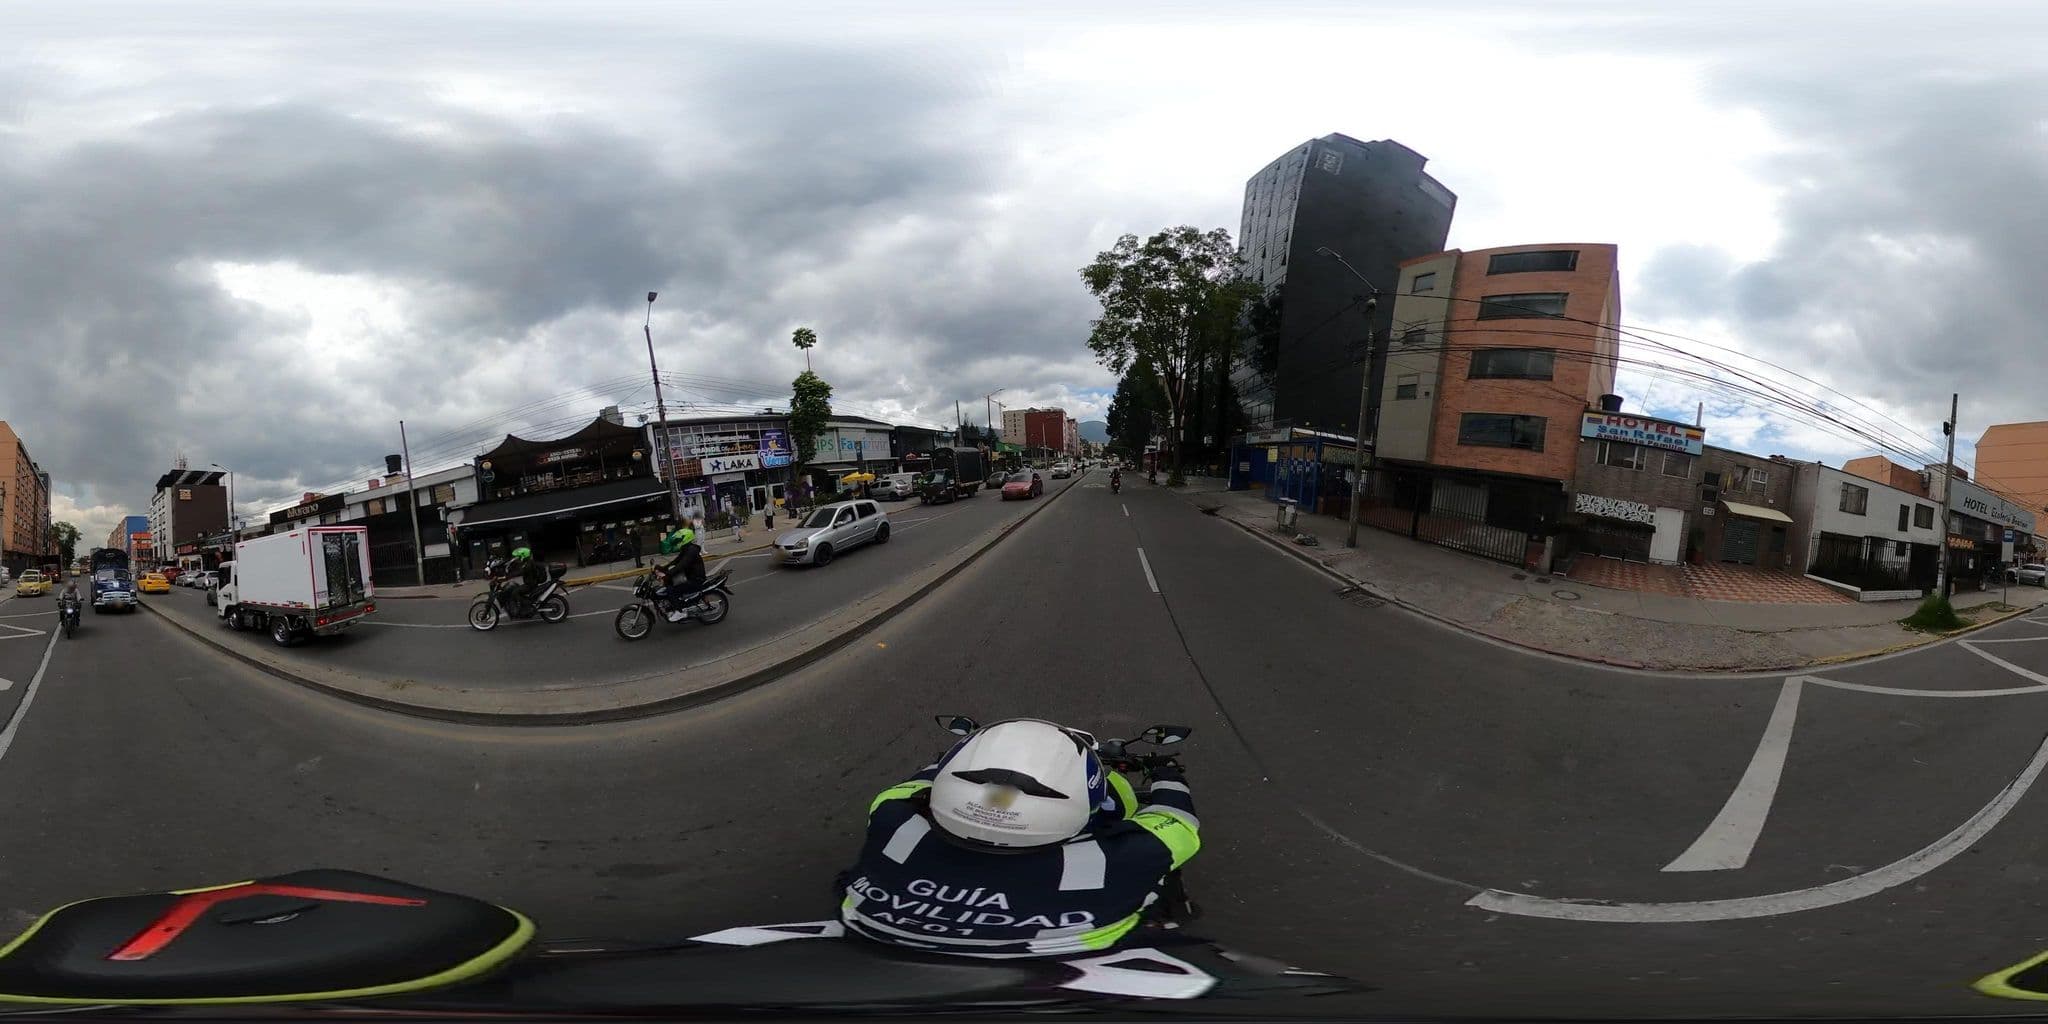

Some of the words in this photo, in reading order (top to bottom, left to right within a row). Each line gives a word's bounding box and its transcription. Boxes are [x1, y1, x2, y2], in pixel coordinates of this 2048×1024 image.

[1606, 414, 1682, 437] HOTEL
[816, 438, 834, 451] IPS
[1596, 432, 1645, 445] Ambiente
[1597, 424, 1628, 436] San
[1633, 429, 1689, 447] Rafael
[723, 457, 754, 471] LAIKA
[287, 503, 319, 518] Murano
[1963, 496, 1988, 515] HOTEL
[852, 876, 1096, 928] MOVILIDAD
[906, 878, 1011, 910] GUÍA
